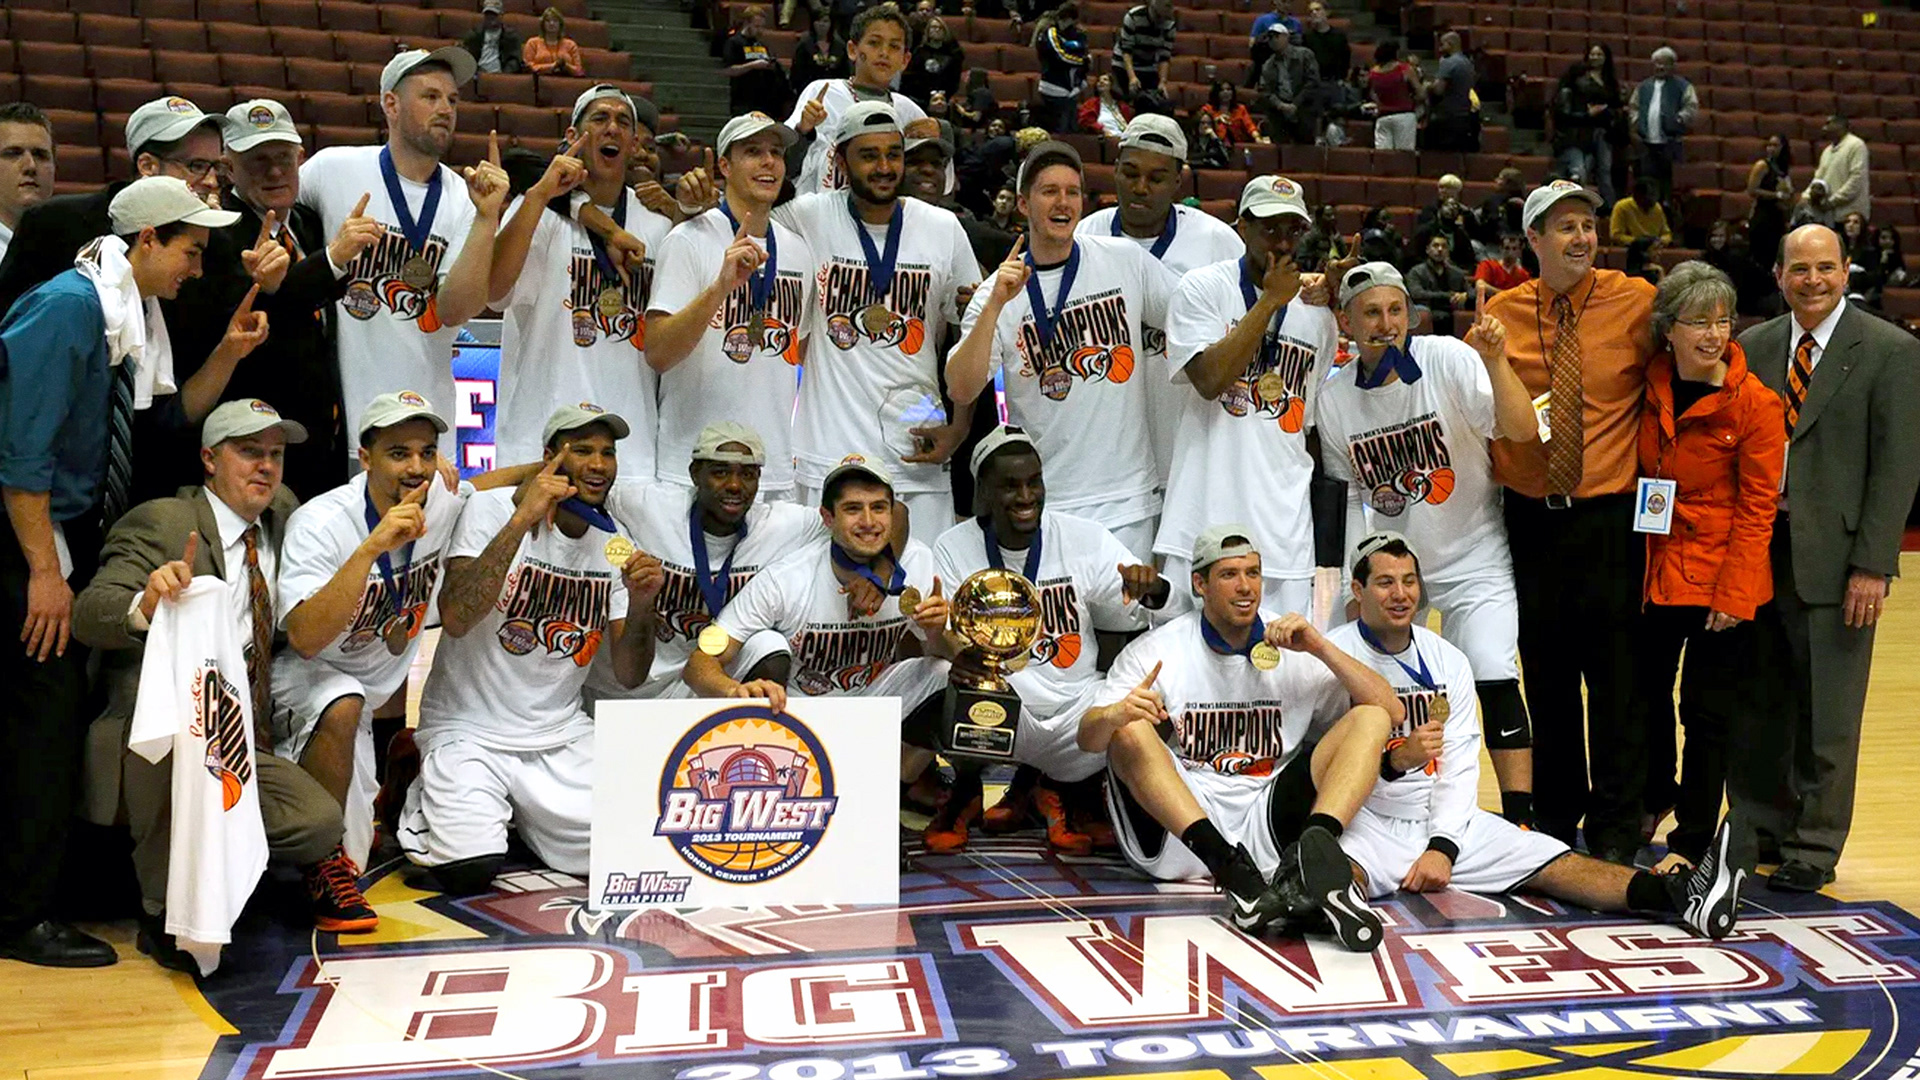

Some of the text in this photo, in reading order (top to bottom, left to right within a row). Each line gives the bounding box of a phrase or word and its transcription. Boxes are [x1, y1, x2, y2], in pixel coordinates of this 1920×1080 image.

[1216, 701, 1250, 709] BASKETBALL
[1181, 708, 1283, 760] CHAMPIONS
[691, 831, 803, 843] 2013 TOURNAMENT
[681, 844, 811, 883] HONDA CENTER ANAHEIM
[602, 893, 684, 904] CHAMPIONS
[684, 999, 1820, 1080] 2013 TOURNAMENT
